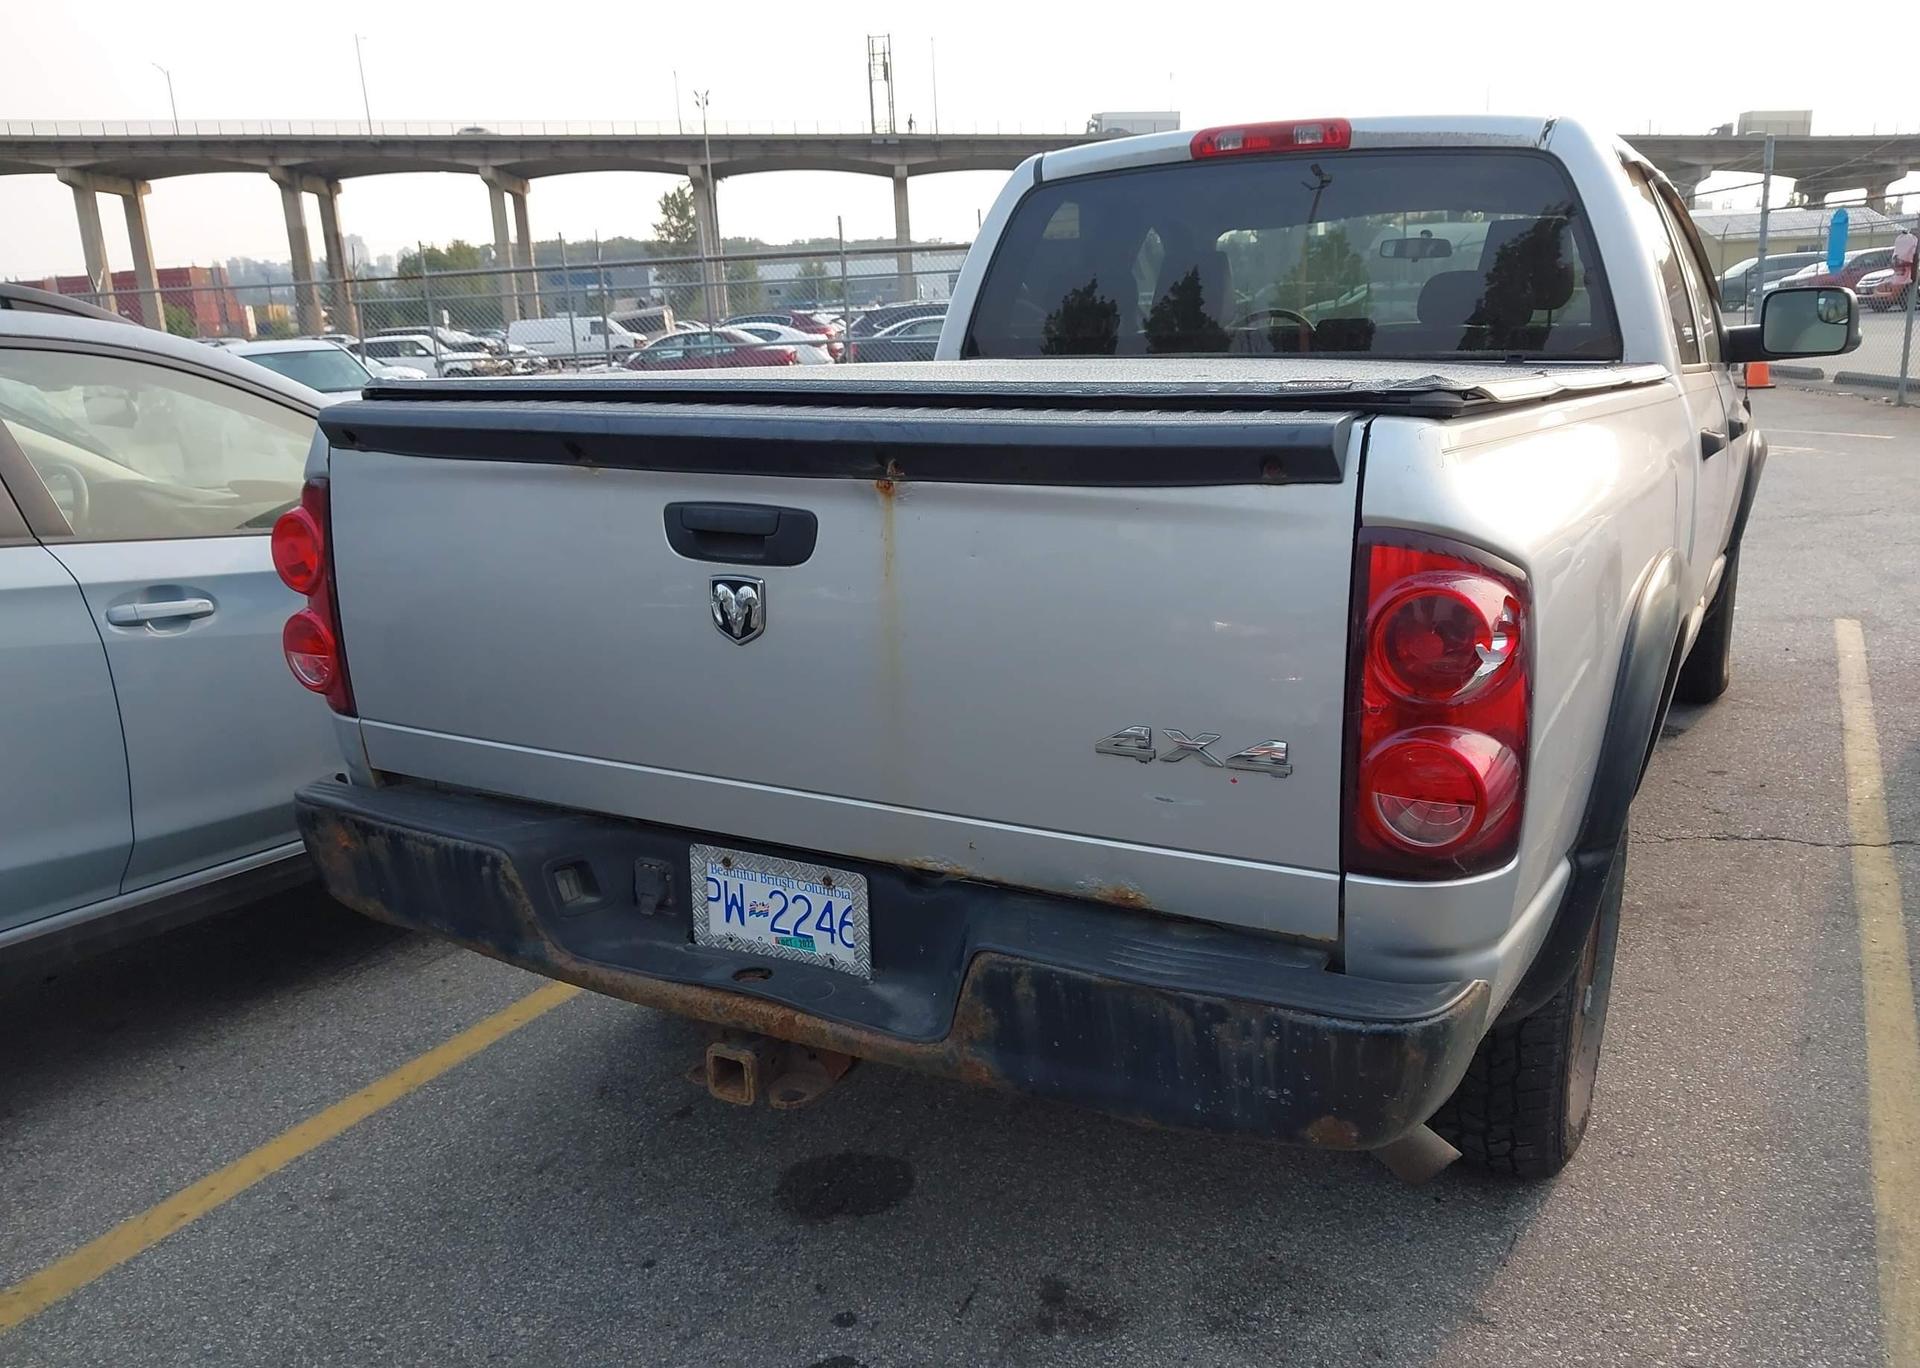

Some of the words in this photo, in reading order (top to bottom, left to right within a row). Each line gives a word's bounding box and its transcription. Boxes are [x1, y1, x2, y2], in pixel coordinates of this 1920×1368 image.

[710, 863, 757, 883] Beautiful
[760, 873, 794, 890] British
[796, 880, 850, 900] Columbia
